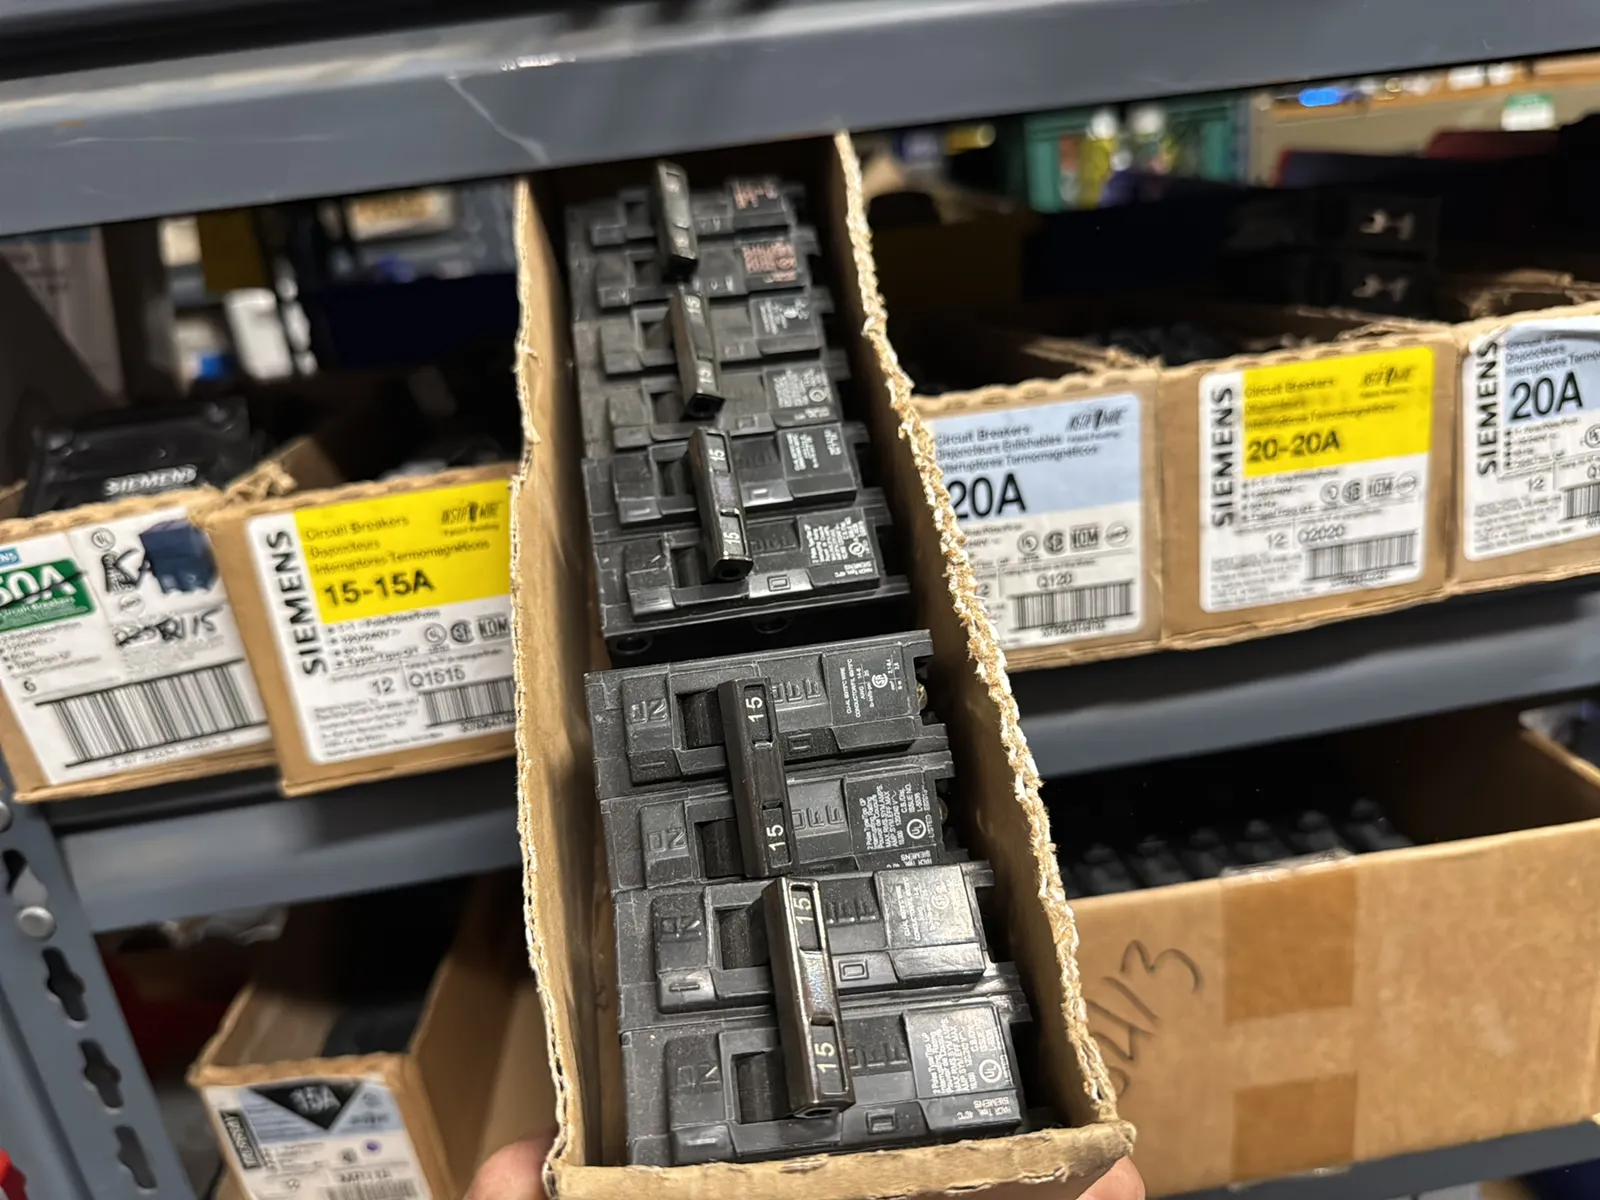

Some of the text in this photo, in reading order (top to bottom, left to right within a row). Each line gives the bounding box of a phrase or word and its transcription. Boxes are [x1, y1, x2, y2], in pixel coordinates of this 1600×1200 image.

[1476, 341, 1499, 476] SIEMENS
[1508, 370, 1584, 421] 20A
[976, 425, 1031, 441] Breakers
[1246, 430, 1341, 464] 20-20A
[709, 449, 726, 463] 15
[1210, 386, 1234, 527] SIEMENS
[948, 473, 1027, 520] 20A
[306, 515, 410, 540] Circuit Breakers
[724, 532, 741, 545] 15
[1266, 532, 1288, 549] 12
[324, 568, 436, 607] 15-15A
[1036, 571, 1074, 589] Q120
[266, 530, 329, 675] SIEMENS
[371, 677, 395, 695] 12
[408, 663, 467, 688] Q1515
[745, 695, 765, 723] 15
[905, 794, 915, 813] ISSUE
[766, 823, 785, 852] 15
[924, 814, 935, 837] LISTED
[792, 896, 814, 924] 15
[815, 1041, 837, 1074] 15
